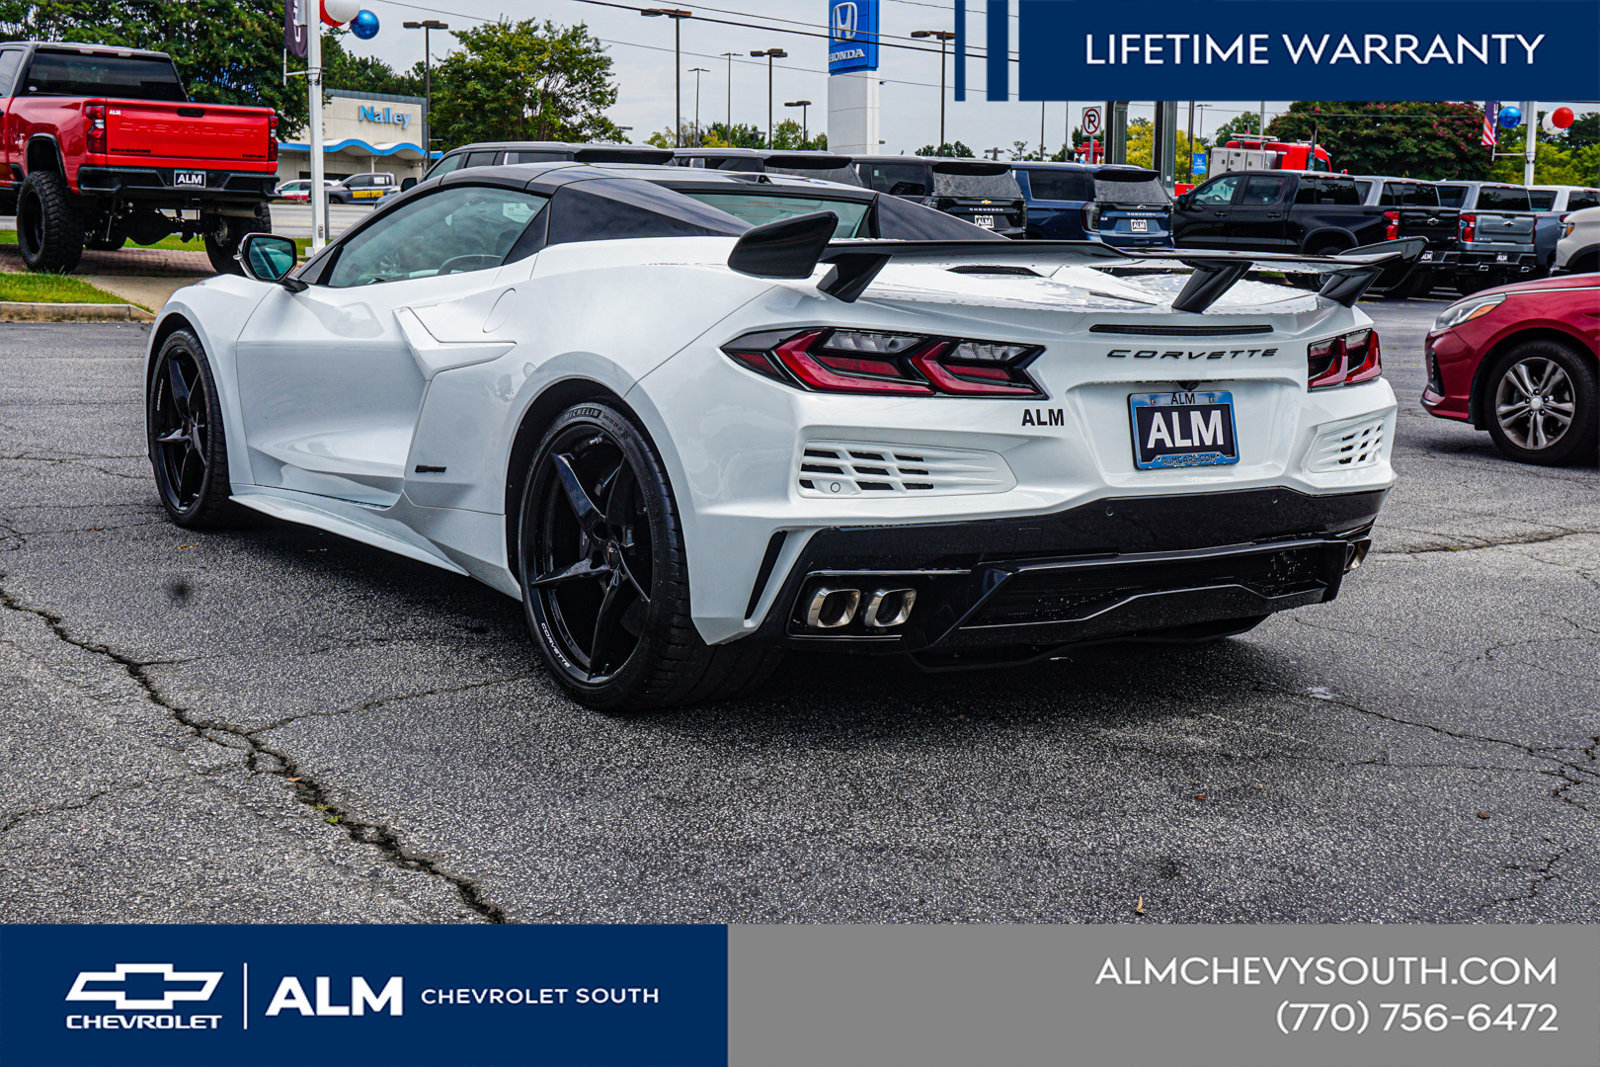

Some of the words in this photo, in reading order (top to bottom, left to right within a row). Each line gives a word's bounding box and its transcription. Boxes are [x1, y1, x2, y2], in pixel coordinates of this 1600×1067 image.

[829, 48, 866, 63] HONDA
[358, 105, 412, 129] Nalley
[119, 121, 259, 138] CHEVROLET
[177, 173, 203, 185] ALM
[977, 217, 992, 225] ALM
[1133, 222, 1146, 230] ALM
[1107, 348, 1279, 360] CORVETTE
[1170, 392, 1196, 405] ALM
[564, 407, 601, 420] MICHELIN
[1021, 409, 1064, 426] ALM
[1146, 409, 1225, 449] ALM
[1162, 453, 1218, 466] ALMCARS.COM
[541, 622, 571, 668] CORVETTE
